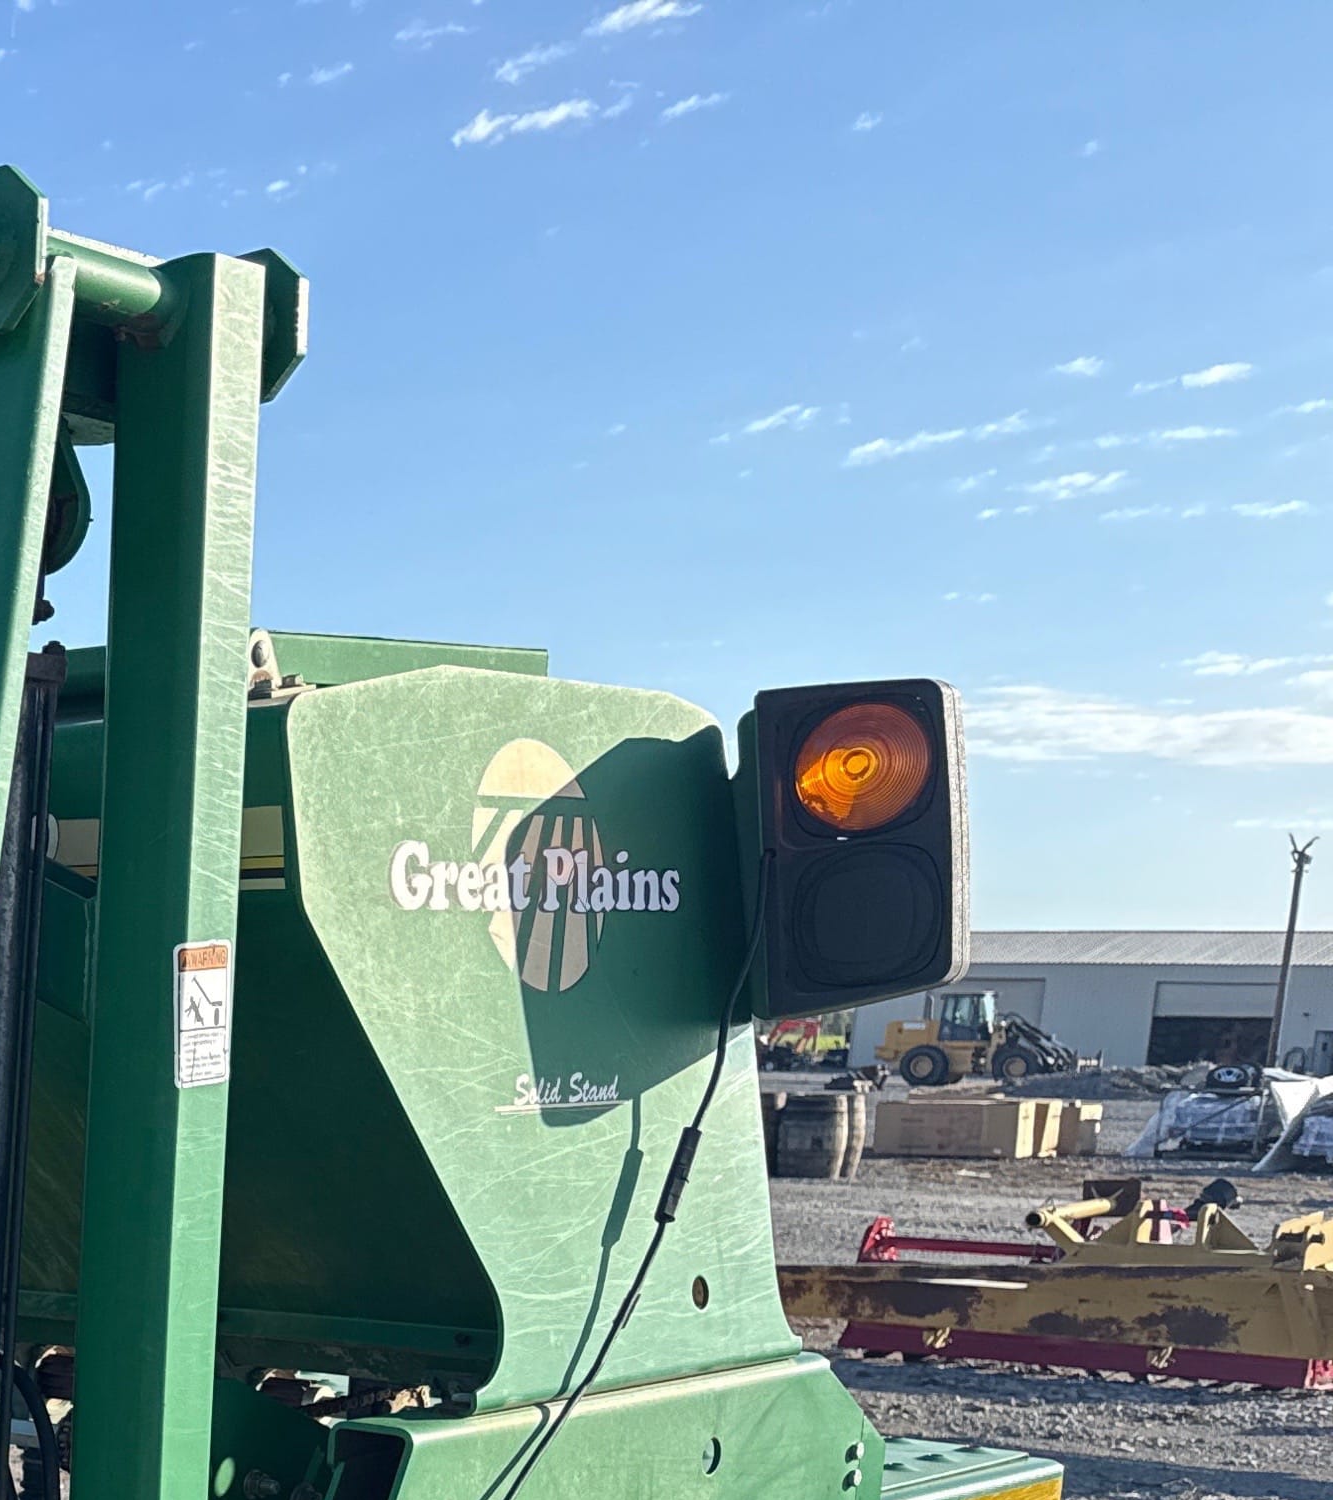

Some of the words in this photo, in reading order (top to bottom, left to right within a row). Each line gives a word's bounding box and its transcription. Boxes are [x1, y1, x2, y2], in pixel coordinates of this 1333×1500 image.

[389, 839, 532, 912] Great
[541, 846, 681, 912] Plains
[514, 1075, 563, 1106] Solid
[568, 1072, 621, 1104] Stand
